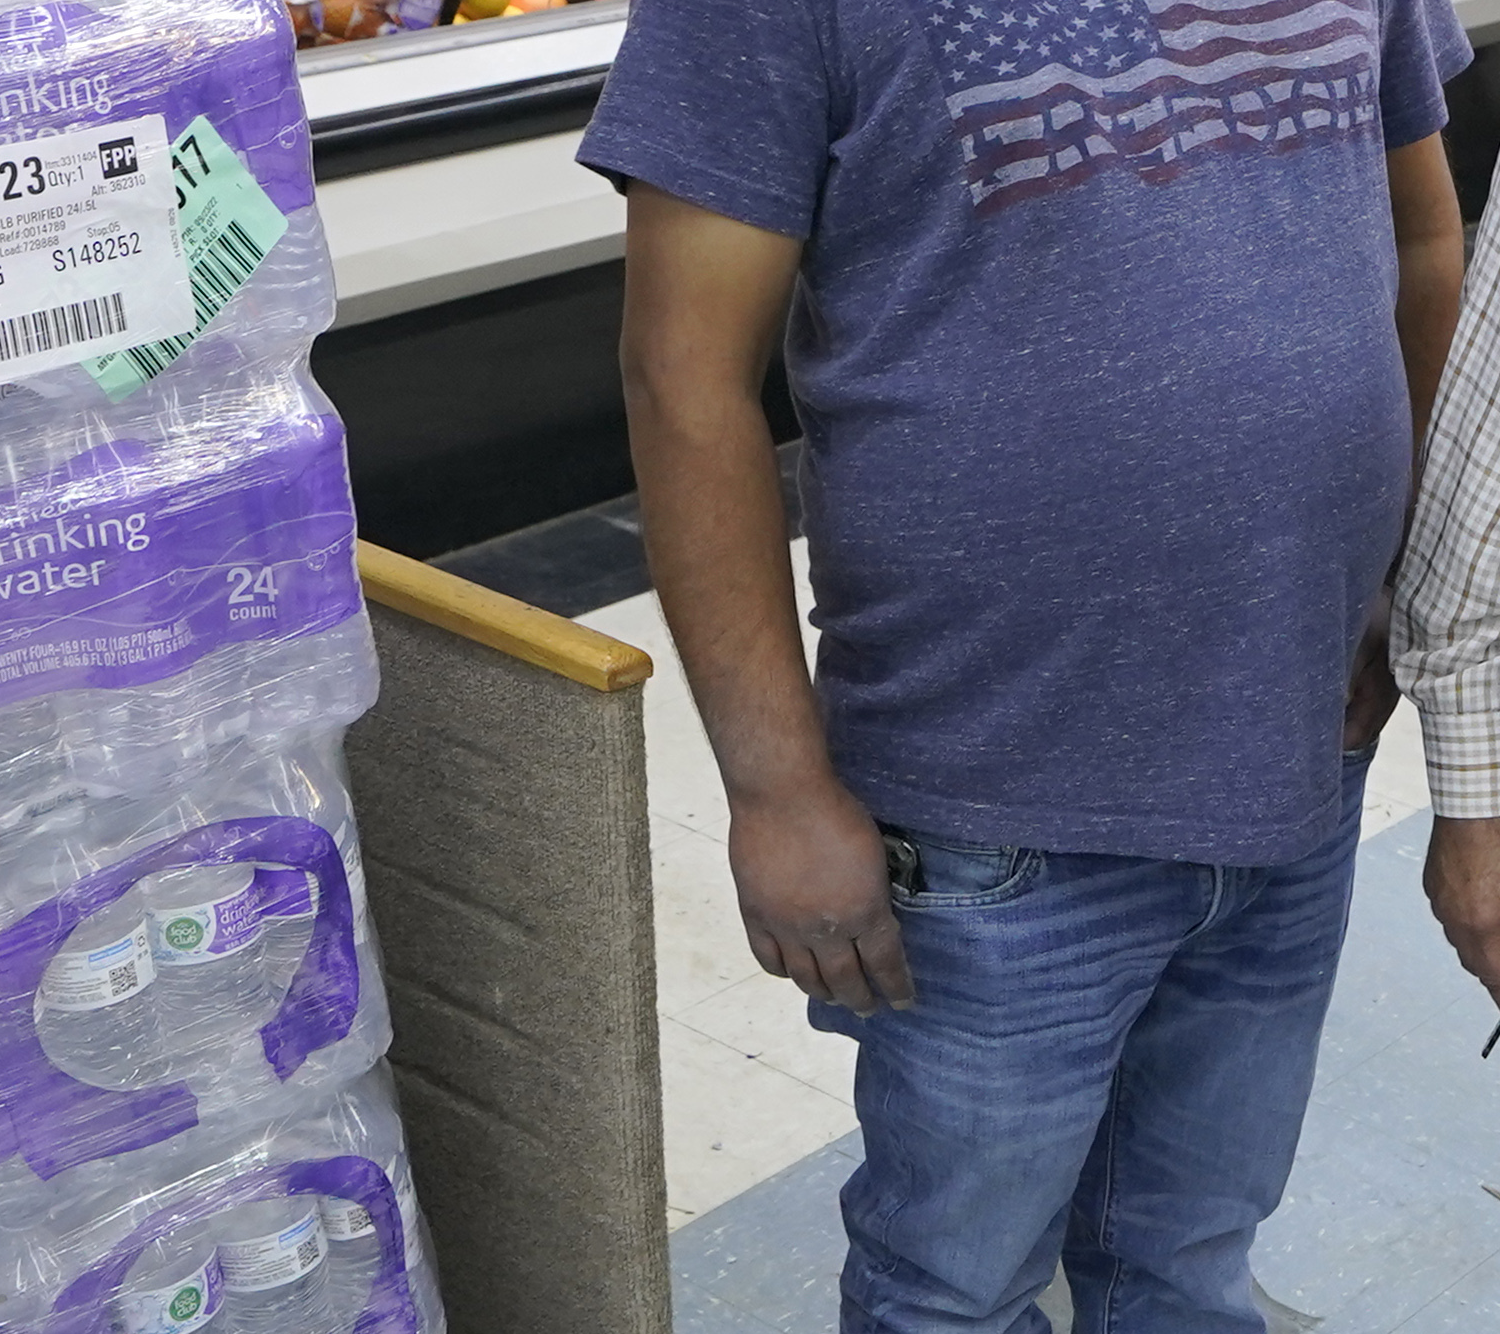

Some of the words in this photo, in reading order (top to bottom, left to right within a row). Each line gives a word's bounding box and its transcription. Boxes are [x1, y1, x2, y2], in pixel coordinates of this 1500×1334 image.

[100, 144, 138, 173] FPP
[48, 166, 86, 188] Qty:1
[91, 183, 108, 198] Alt:
[110, 173, 147, 194] 362310
[16, 206, 64, 229] PURIFIED
[52, 232, 143, 273] S148252
[227, 566, 279, 604] 24
[229, 603, 278, 621] count
[174, 1288, 199, 1309] food
[176, 1300, 201, 1319] club
